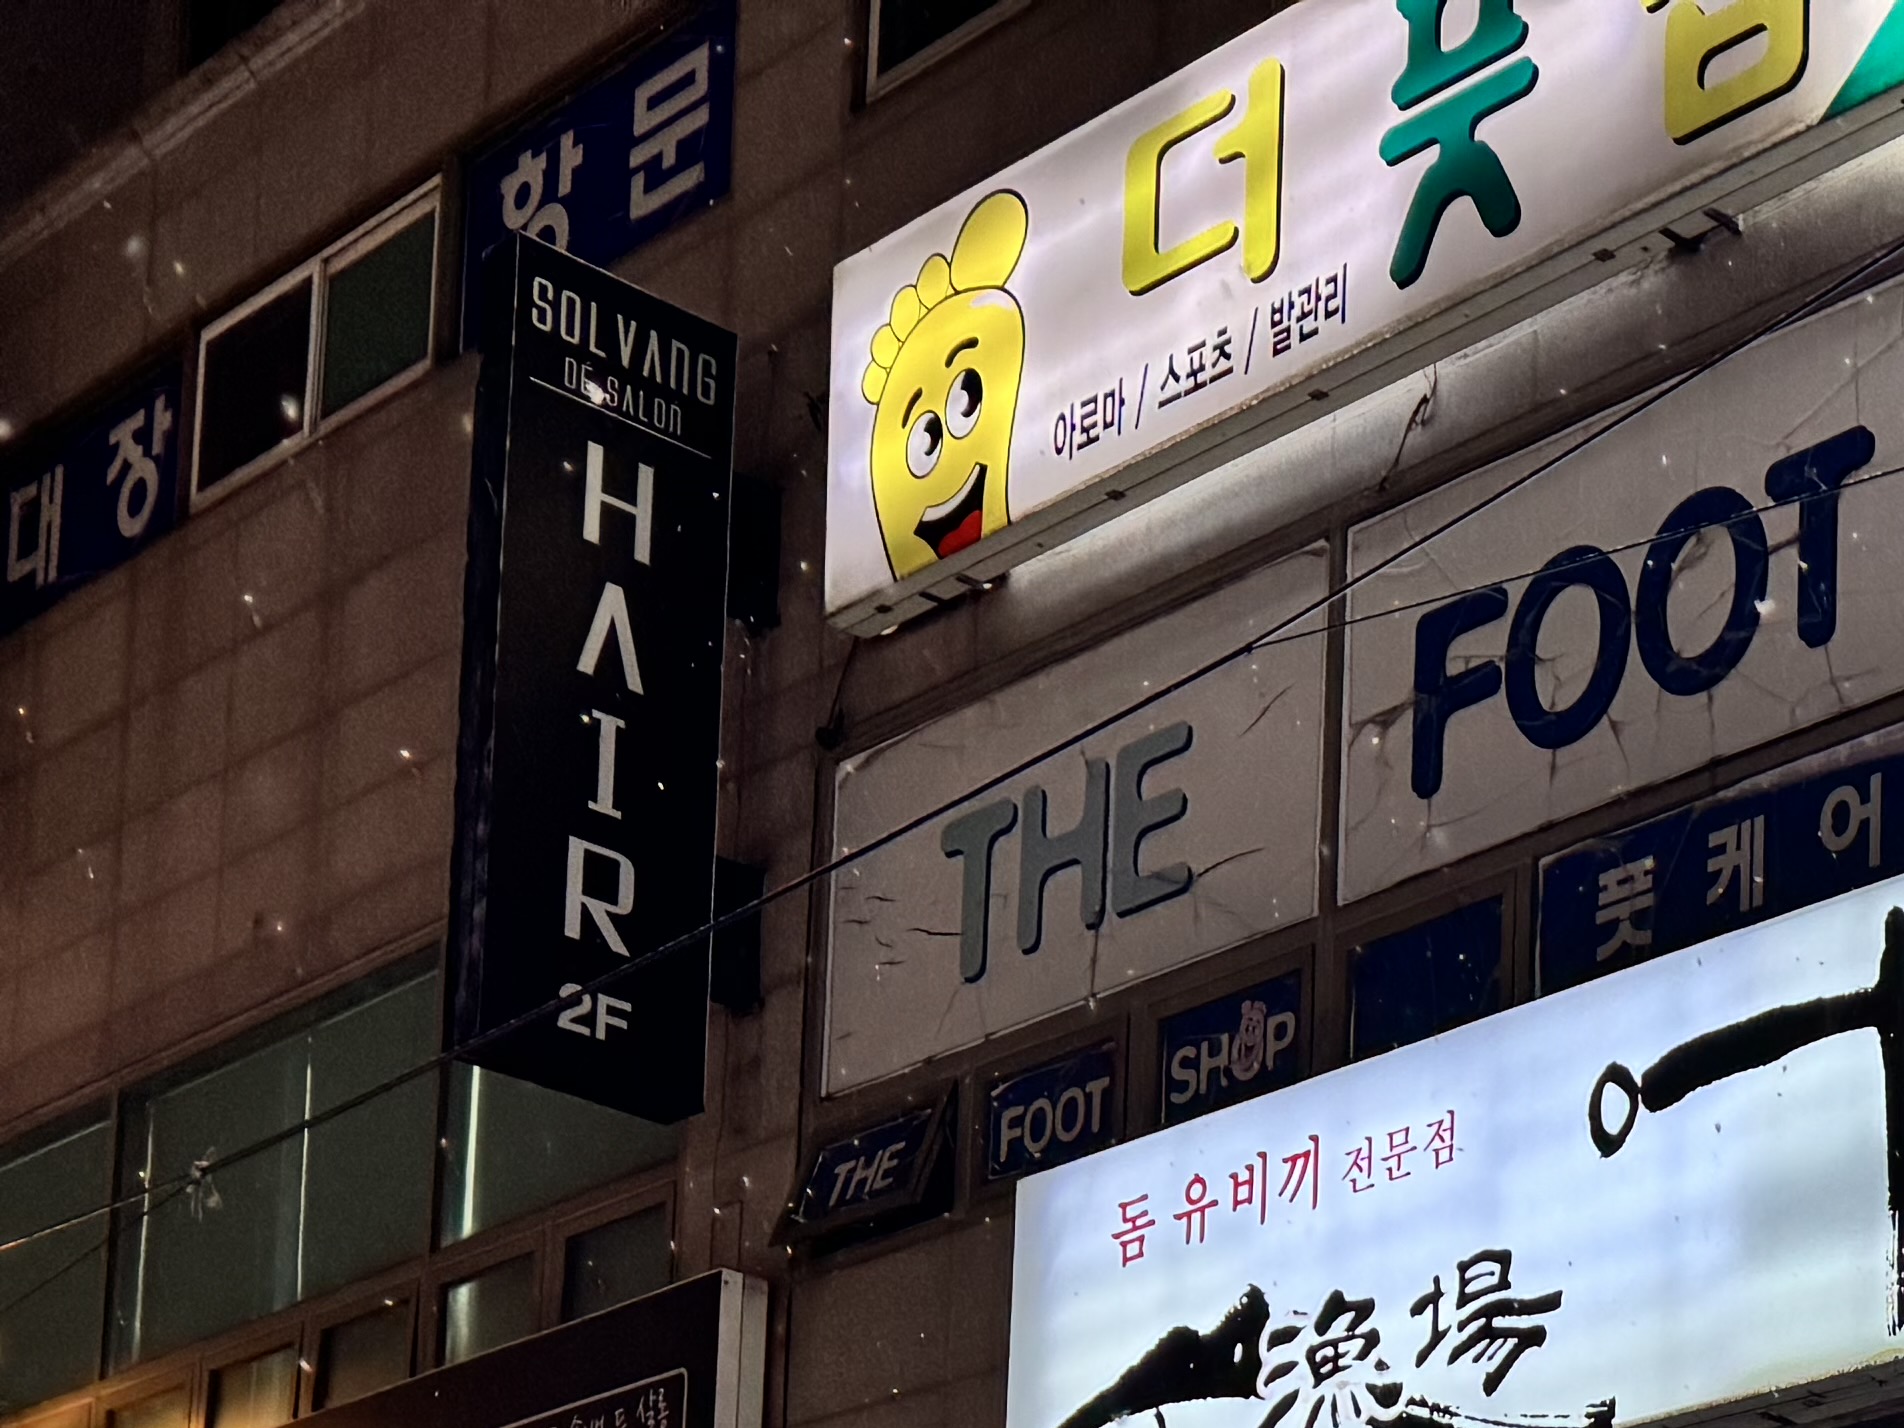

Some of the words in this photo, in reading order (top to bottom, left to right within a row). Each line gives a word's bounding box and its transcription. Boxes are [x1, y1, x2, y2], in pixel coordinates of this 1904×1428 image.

[531, 276, 719, 406] SOLVANG
[1052, 391, 1126, 461] 아로마
[1156, 325, 1234, 408] 스포츠
[1270, 262, 1348, 357] 발관리
[1411, 424, 1876, 800] FOOT
[941, 721, 1195, 984] THE
[557, 983, 632, 1041] 2F
[829, 1144, 905, 1206] THE
[996, 1076, 1110, 1163] FOOT
[1111, 1192, 1157, 1268] 돔
[1173, 1135, 1322, 1245] 유비끼
[1341, 1109, 1461, 1195] 전문점
